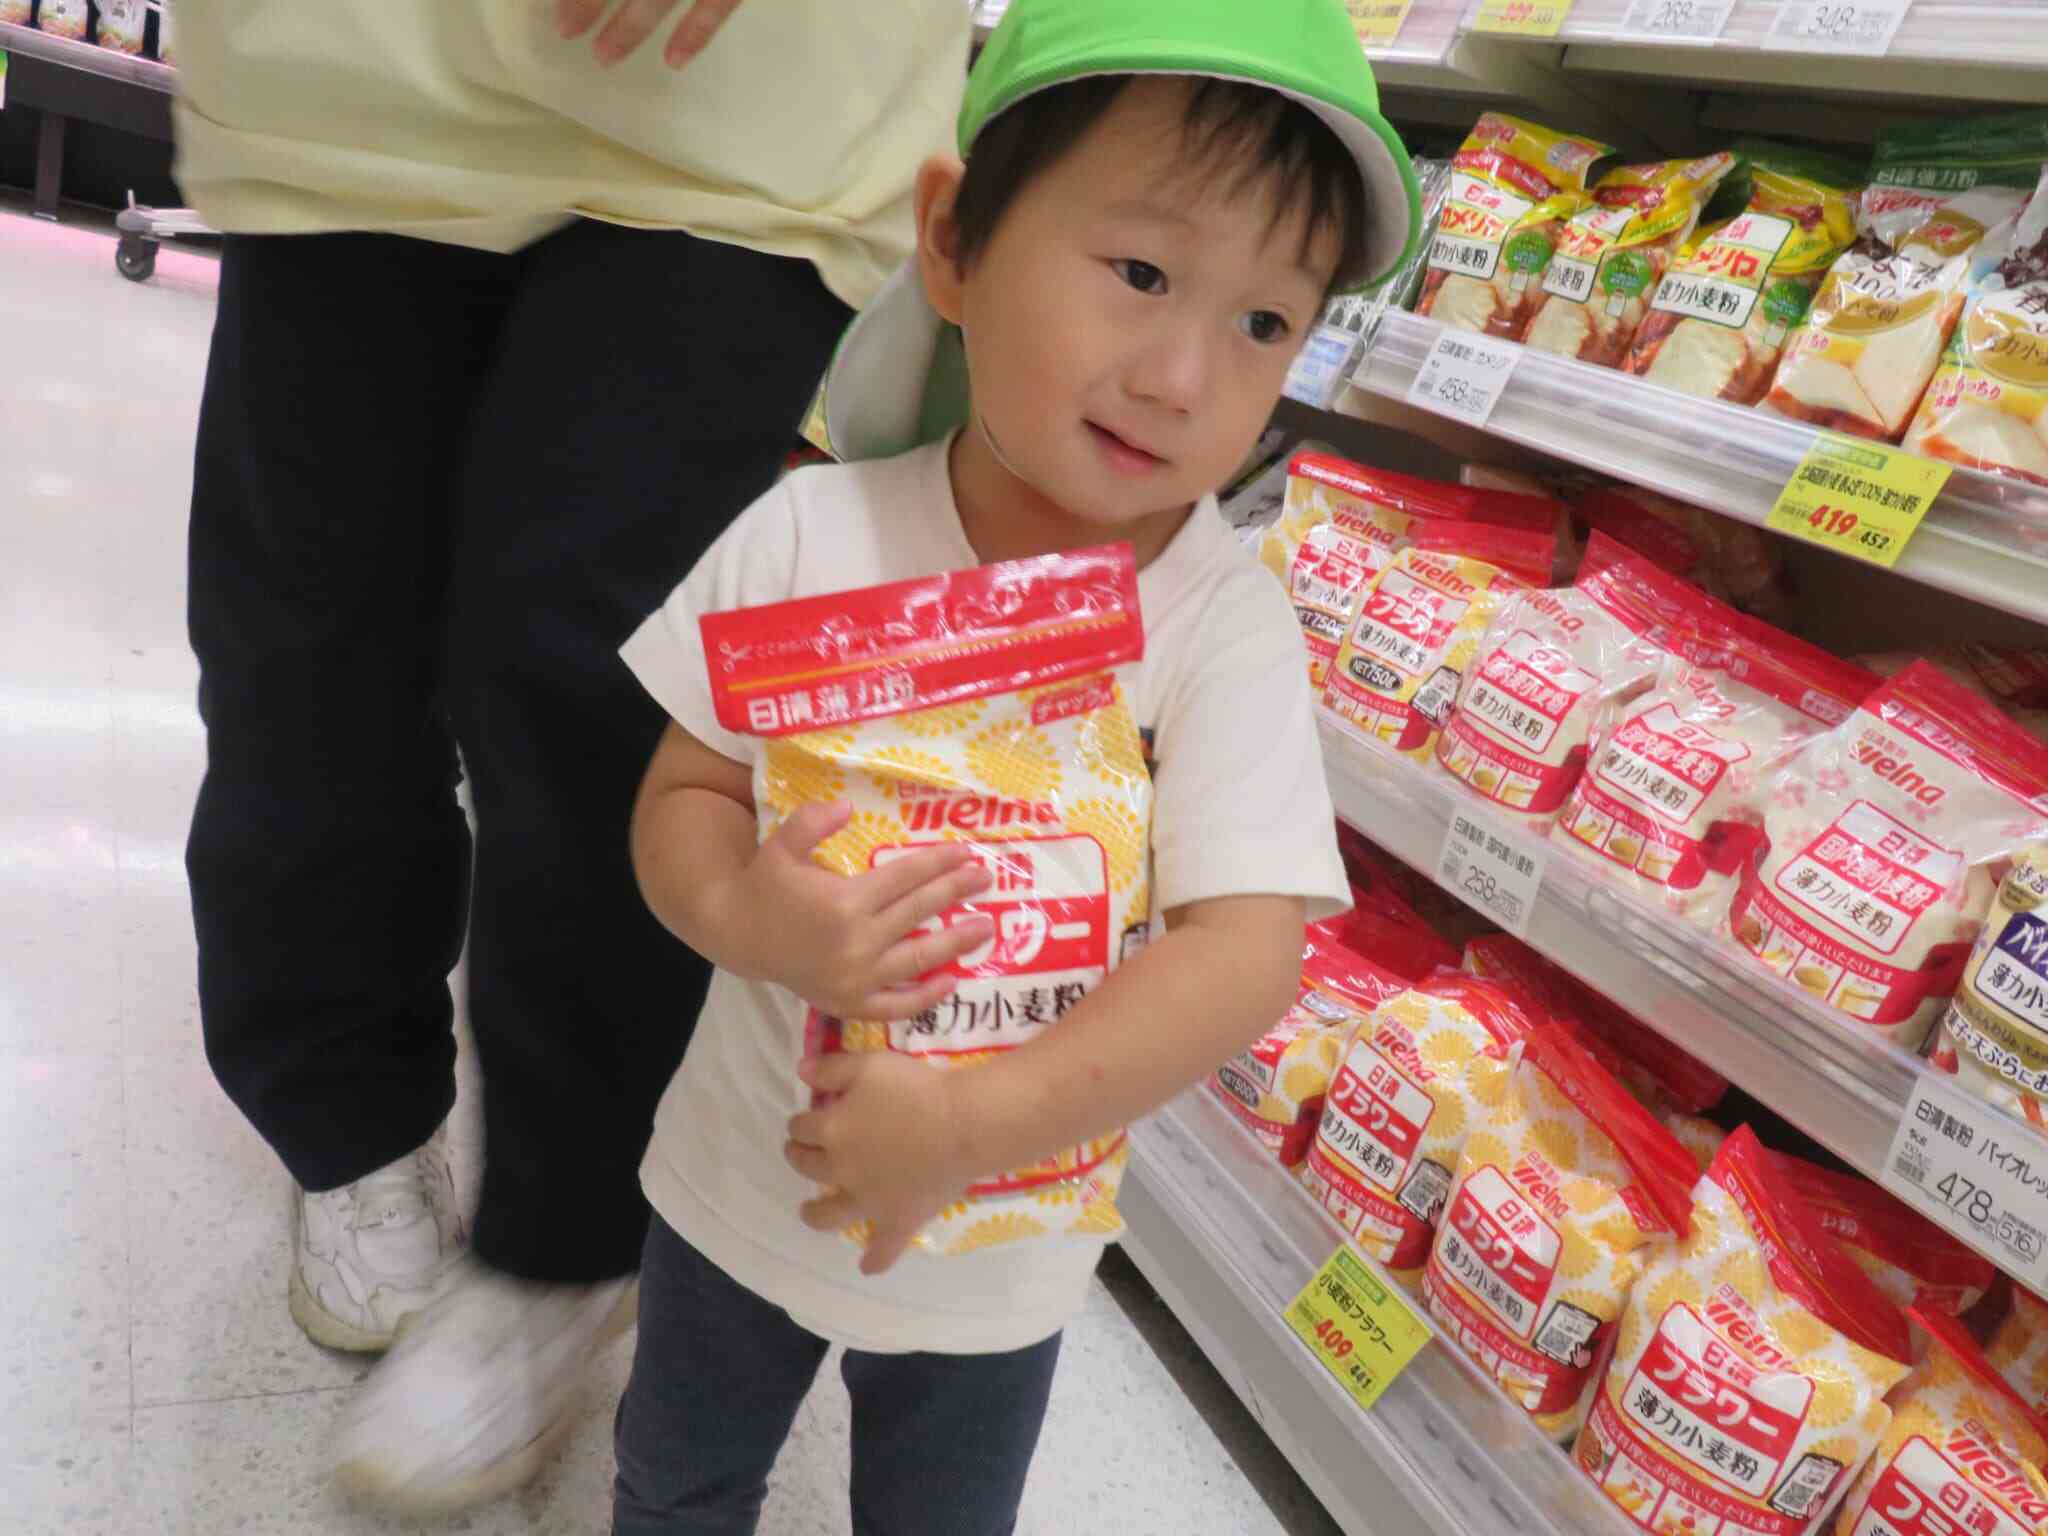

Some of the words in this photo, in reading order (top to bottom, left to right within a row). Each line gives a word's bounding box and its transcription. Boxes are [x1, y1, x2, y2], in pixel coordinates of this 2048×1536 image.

[1808, 6, 1856, 35] 348
[1807, 504, 1858, 535] 419
[1860, 530, 1890, 550] 452
[1464, 864, 1497, 901] 258
[1793, 867, 1894, 937] 薄力小麦粉
[1987, 962, 2048, 1013] 薄力小
[1335, 1071, 1408, 1143] フラワー
[1368, 1064, 1400, 1100] 日清
[1914, 1098, 1975, 1149] 日清製粉
[1936, 1171, 1993, 1224] 478
[1458, 1197, 1538, 1283] フラワー
[1446, 1237, 1523, 1322] 薄力小麦粉
[1314, 1318, 1355, 1361] 409
[1318, 1272, 1395, 1354] 小麦粉フラワー
[1652, 1345, 1780, 1438] フラワー
[1633, 1386, 1761, 1483] 薄力小麦粉
